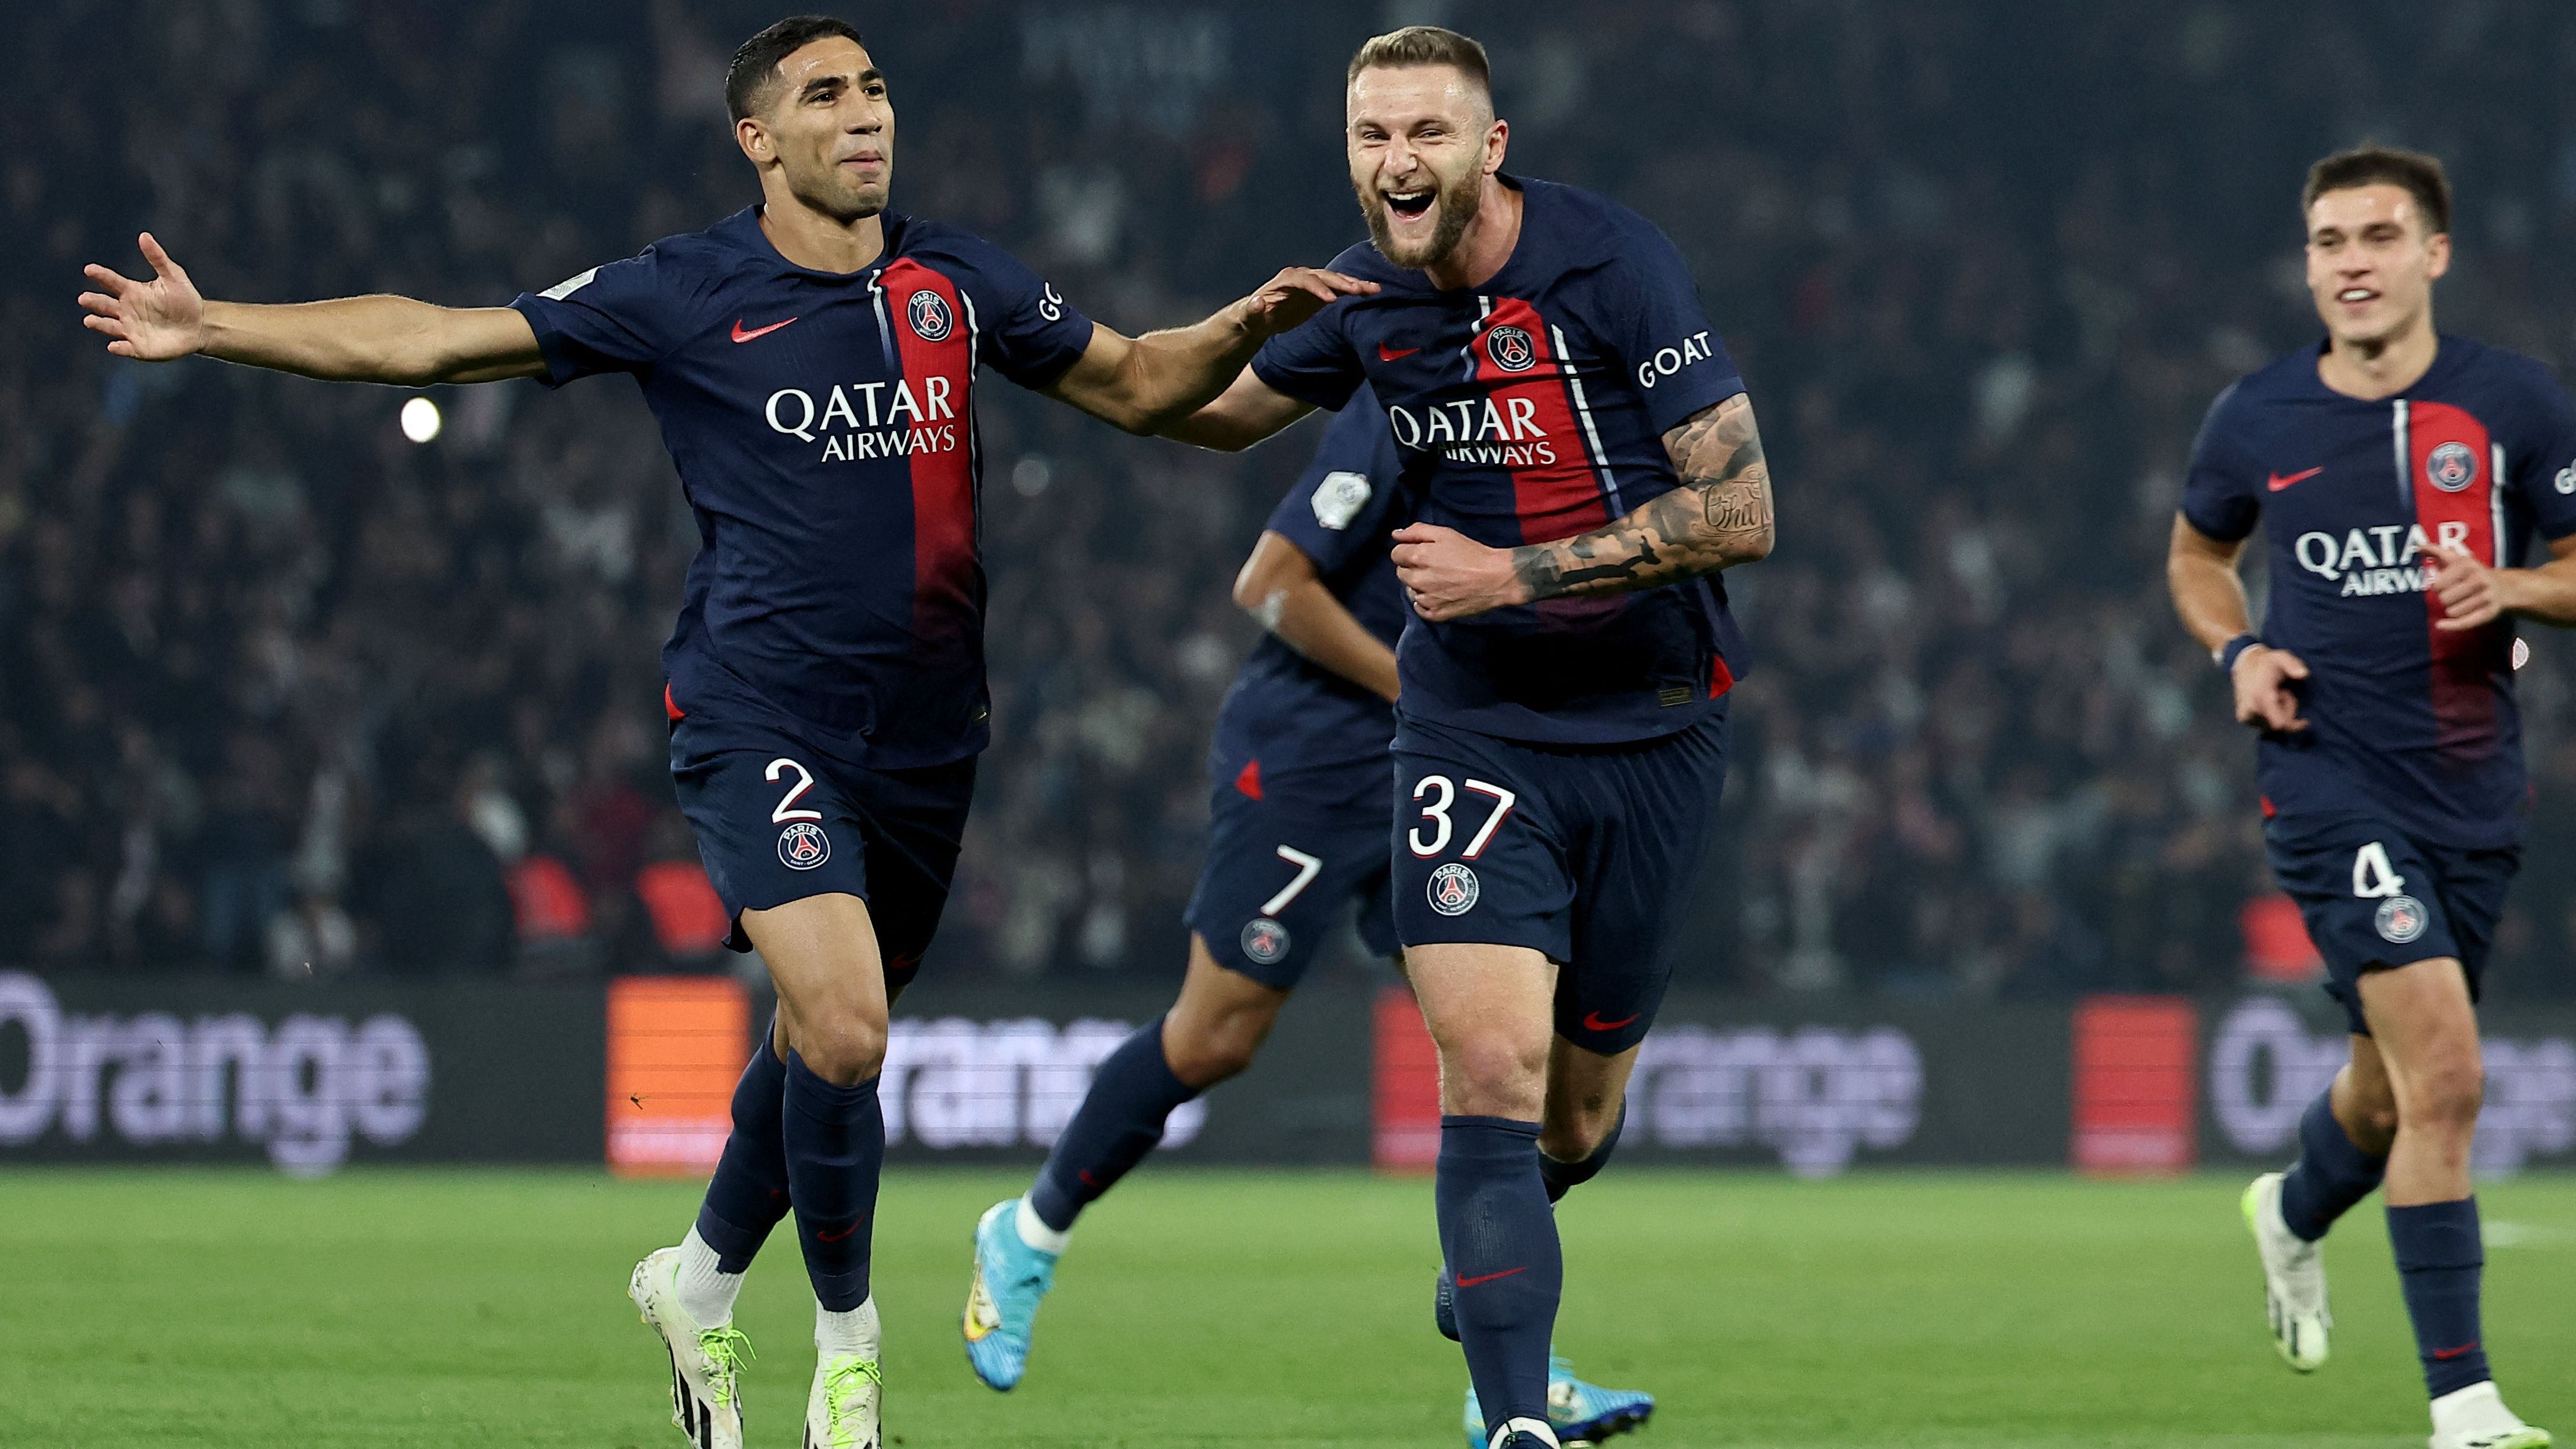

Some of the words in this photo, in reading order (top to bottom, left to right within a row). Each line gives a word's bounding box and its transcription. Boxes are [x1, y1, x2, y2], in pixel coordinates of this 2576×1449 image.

[912, 292, 940, 306] PARIS
[1492, 328, 1524, 340] PARIS
[1638, 331, 1713, 388] GOAT
[765, 376, 955, 443] QATAR
[1390, 398, 1547, 452] QATAR
[821, 424, 956, 462] AIRWAYS
[2295, 521, 2473, 581] QATAR
[2341, 566, 2437, 597] AIRWA
[765, 758, 823, 825] 2
[1409, 775, 1516, 860] 37
[783, 825, 817, 840] PARIS
[1260, 843, 1323, 917] 7
[1435, 865, 1469, 880] PARIS
[2353, 841, 2406, 899] 4
[1623, 1023, 1924, 1180] range
